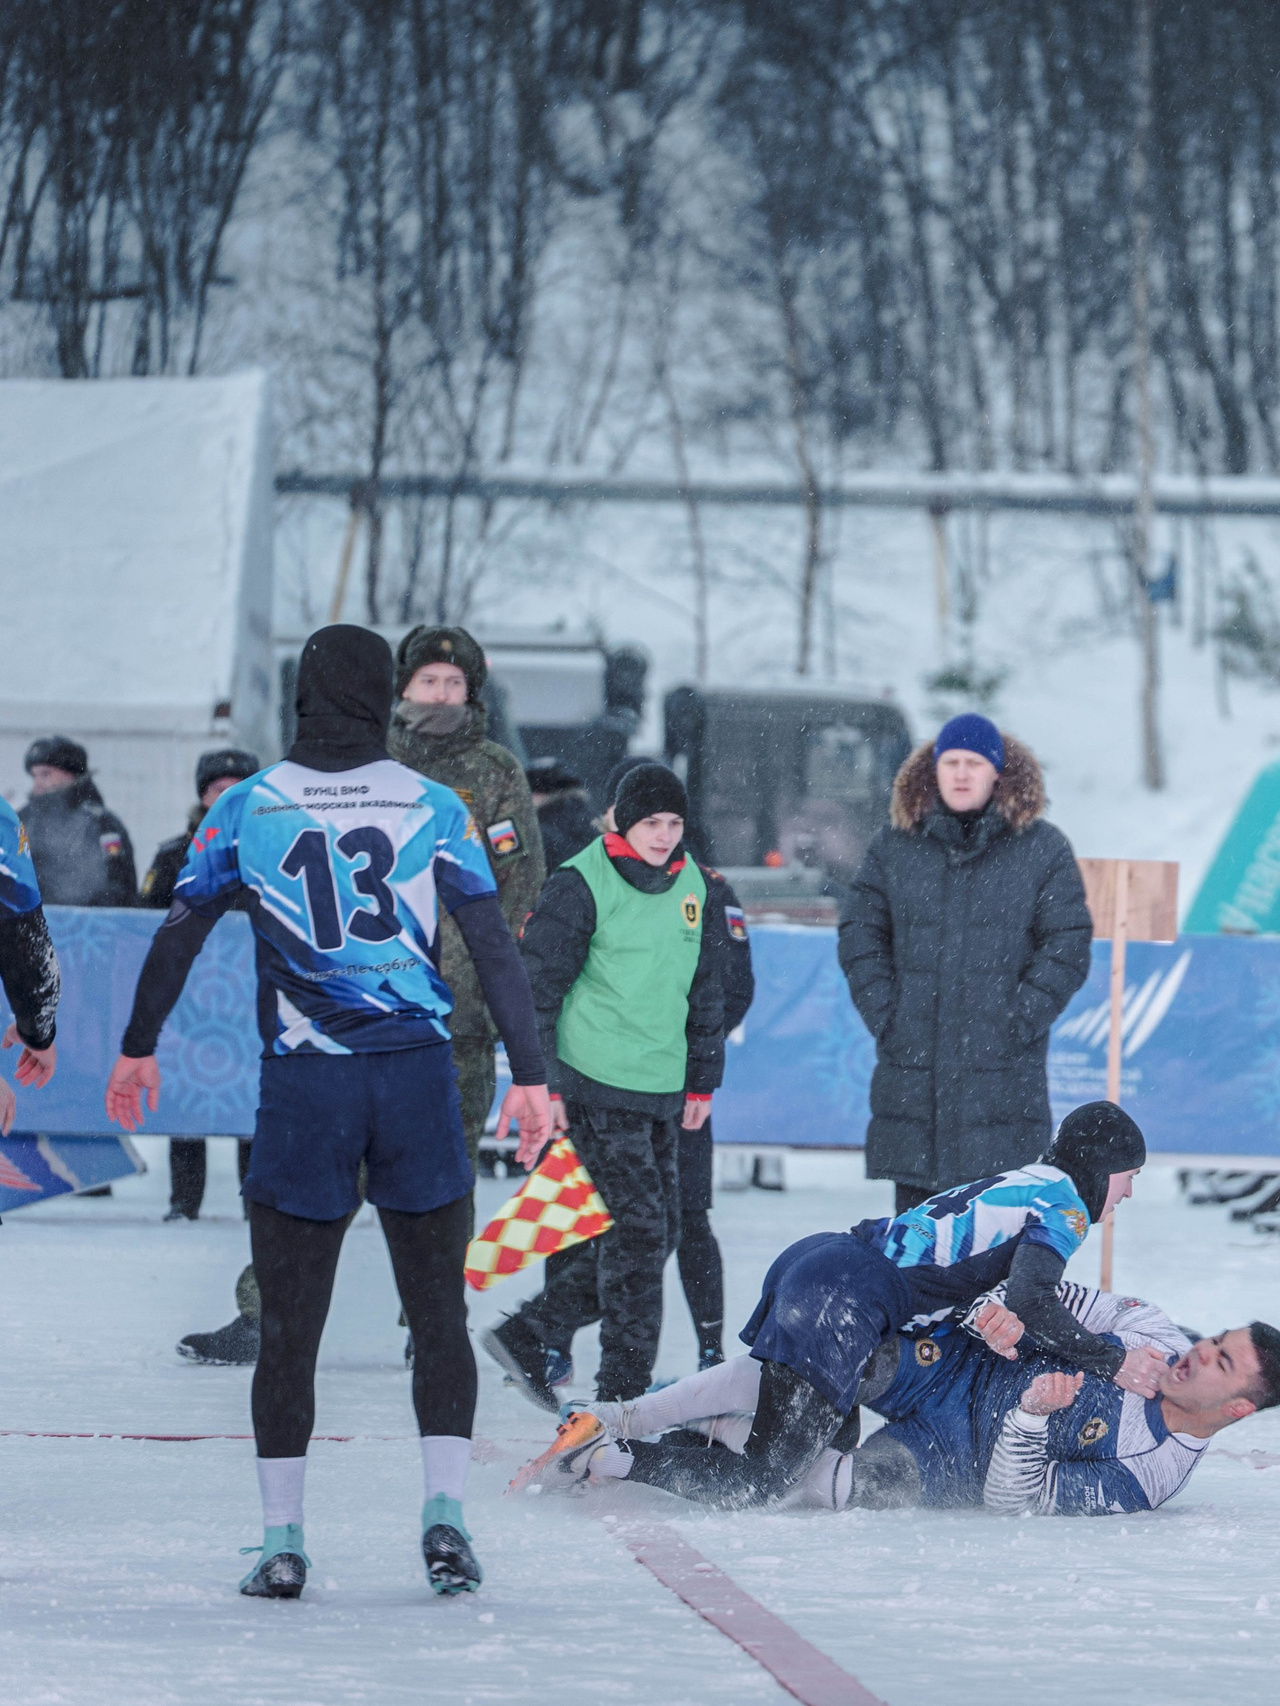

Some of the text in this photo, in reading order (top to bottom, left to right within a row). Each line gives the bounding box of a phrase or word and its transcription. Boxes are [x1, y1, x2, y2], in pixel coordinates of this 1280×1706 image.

[303, 785, 371, 797] ВУНЦ ВМФ
[278, 826, 403, 952] 13
